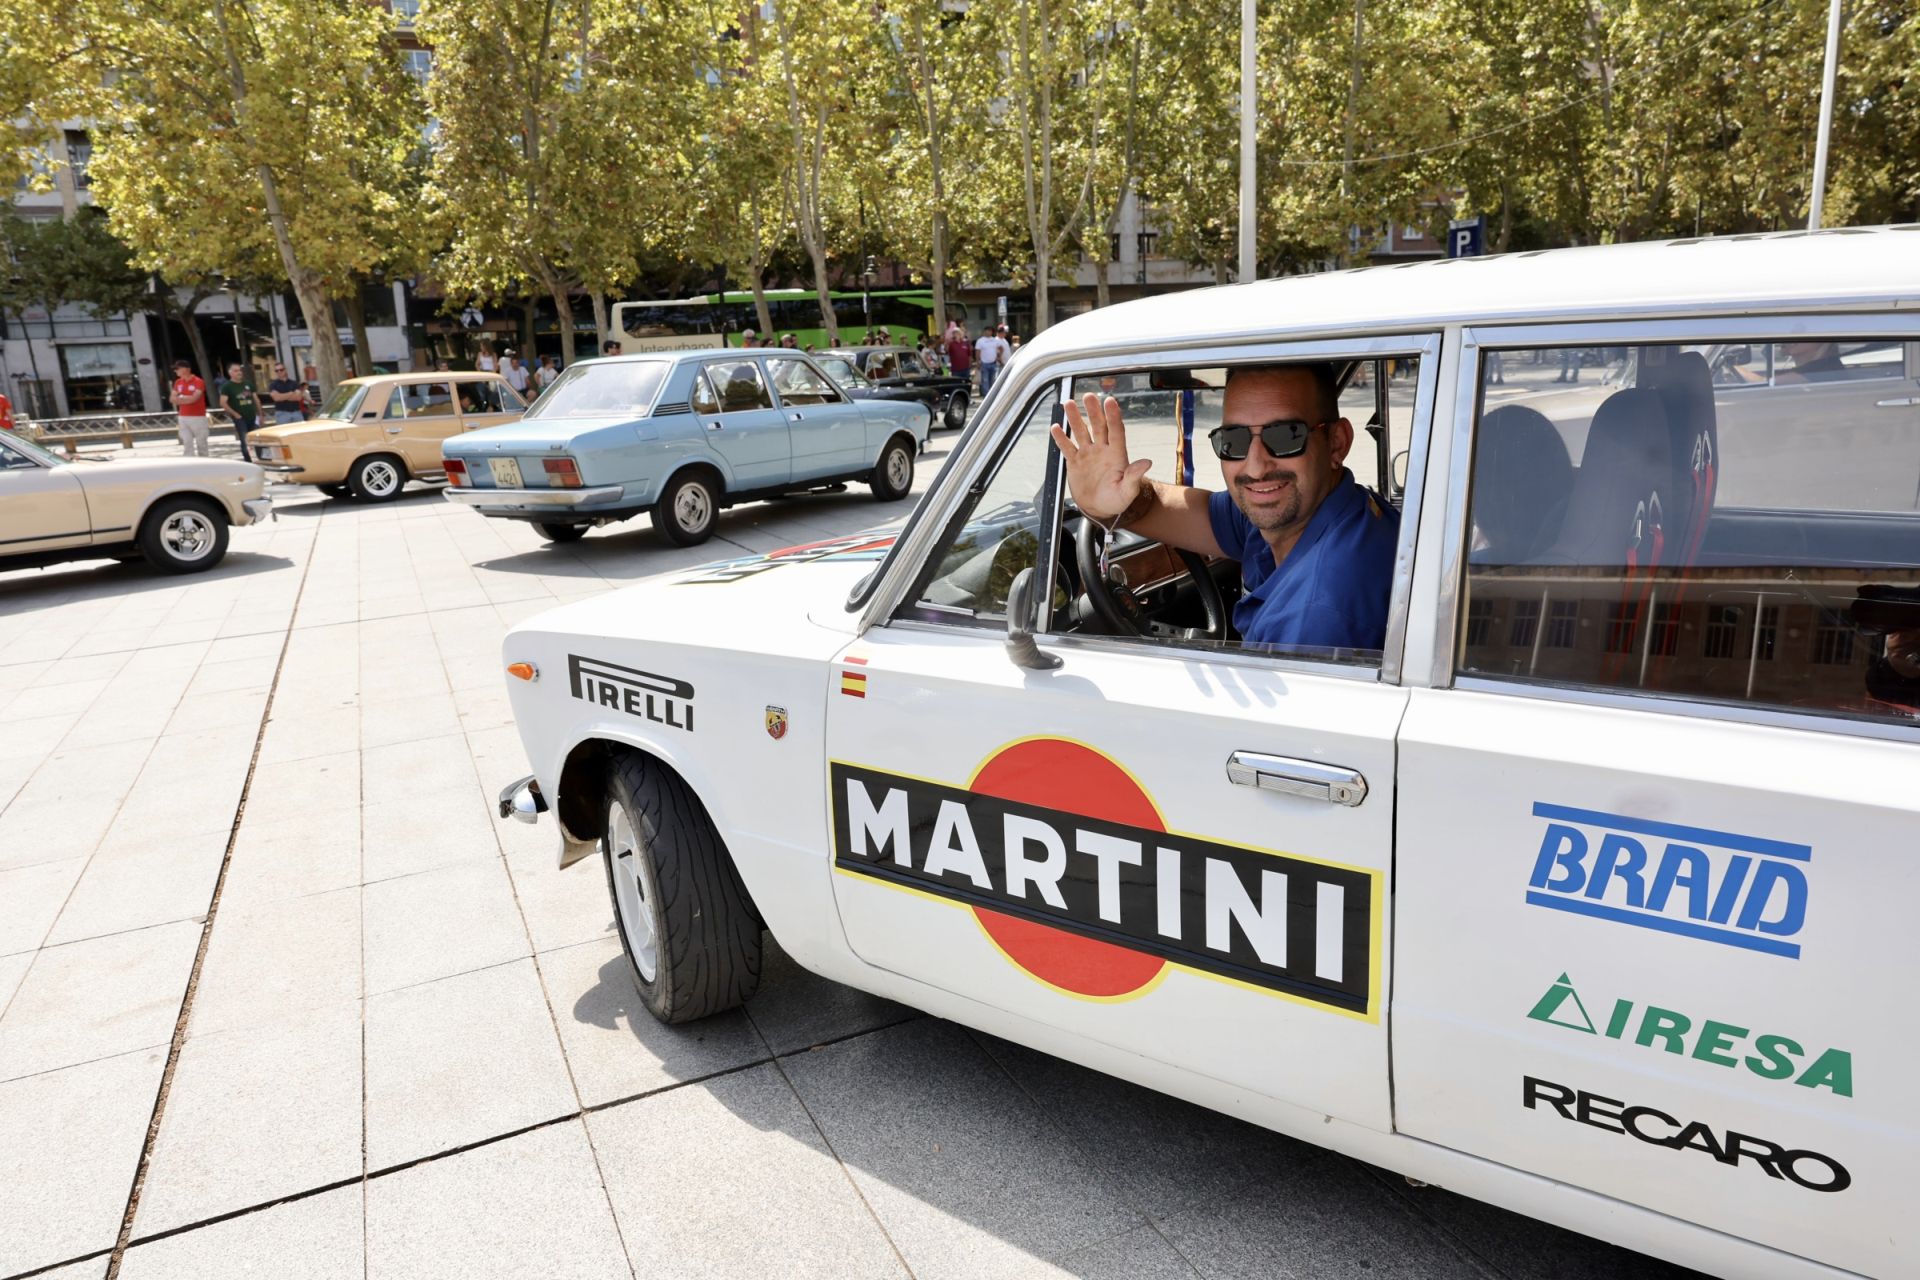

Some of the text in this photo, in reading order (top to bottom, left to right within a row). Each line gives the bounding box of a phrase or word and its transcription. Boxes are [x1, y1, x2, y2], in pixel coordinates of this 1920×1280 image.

[1456, 231, 1471, 257] P
[497, 472, 519, 485] 4421
[567, 653, 694, 732] PIRELLI
[846, 777, 1345, 983] MARTINI
[1528, 823, 1809, 938] BRAID
[1523, 1075, 1852, 1193] RECARO
